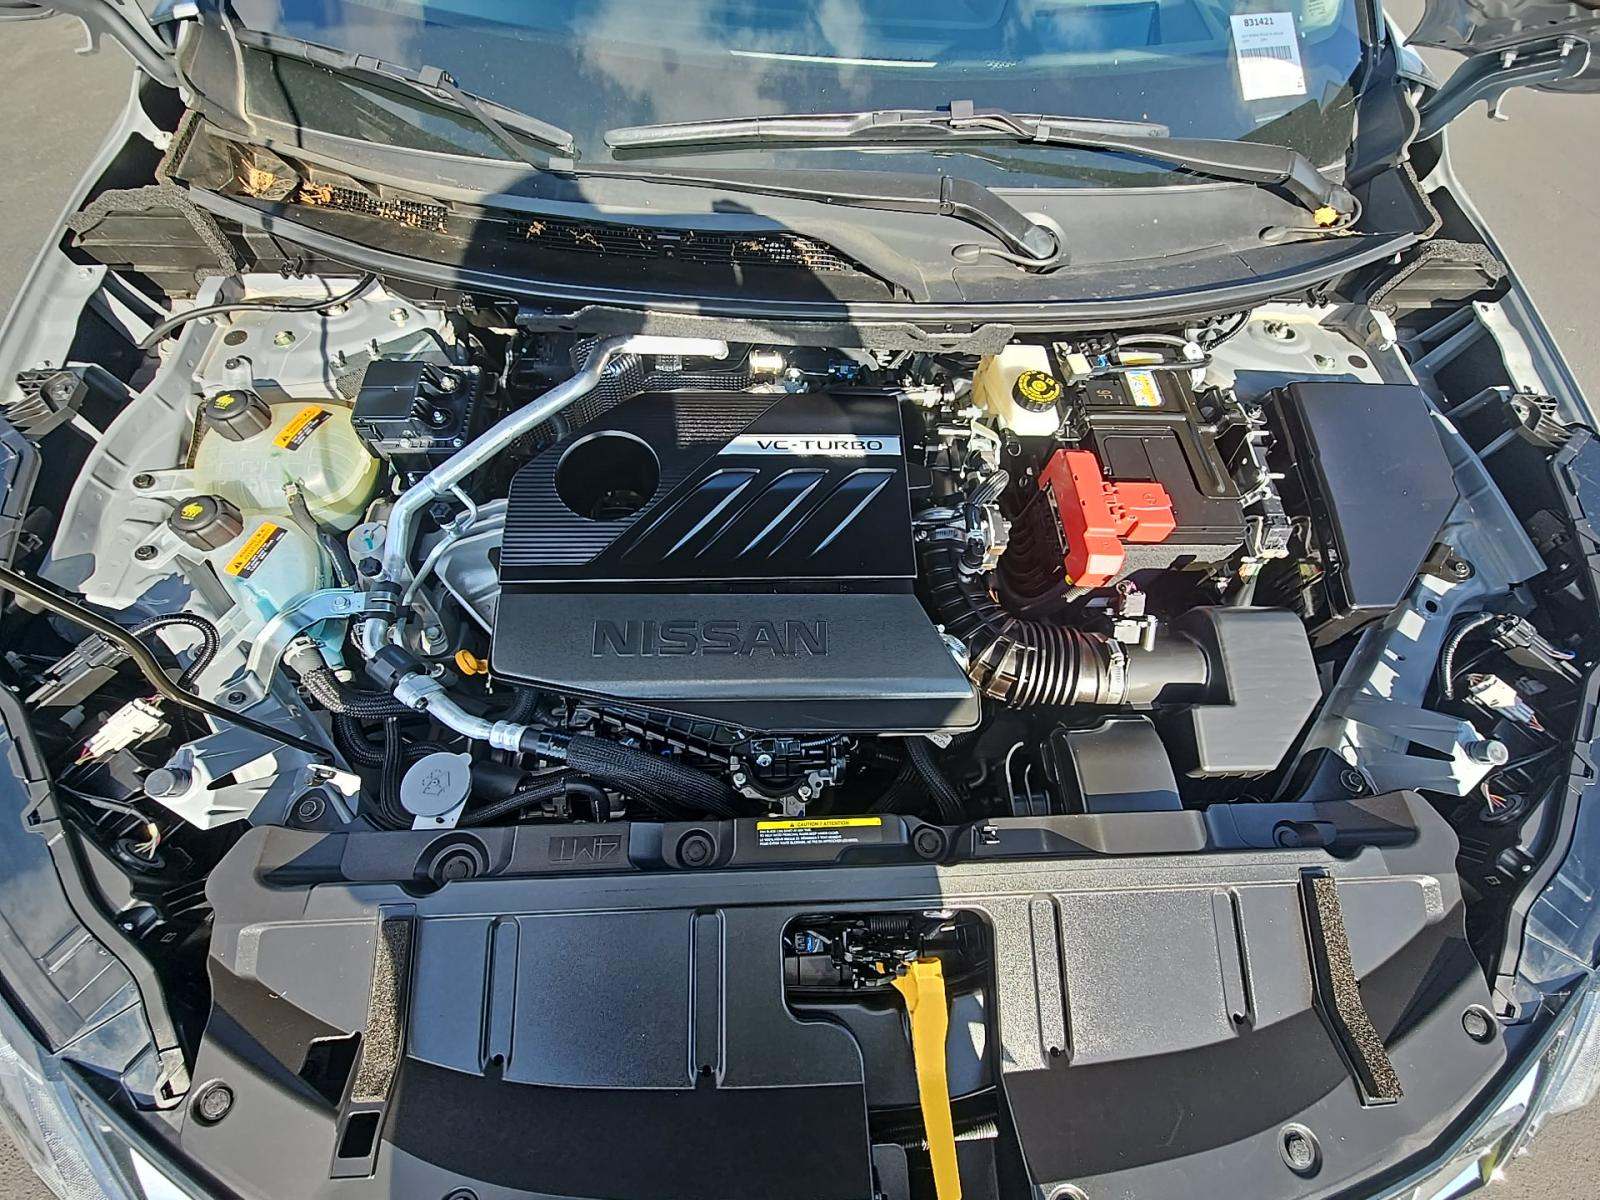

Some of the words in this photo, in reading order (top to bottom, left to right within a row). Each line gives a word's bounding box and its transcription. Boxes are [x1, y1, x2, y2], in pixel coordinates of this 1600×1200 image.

[1244, 17, 1274, 27] 831421
[757, 440, 883, 450] VC-TURBO
[591, 620, 829, 656] NISSAN
